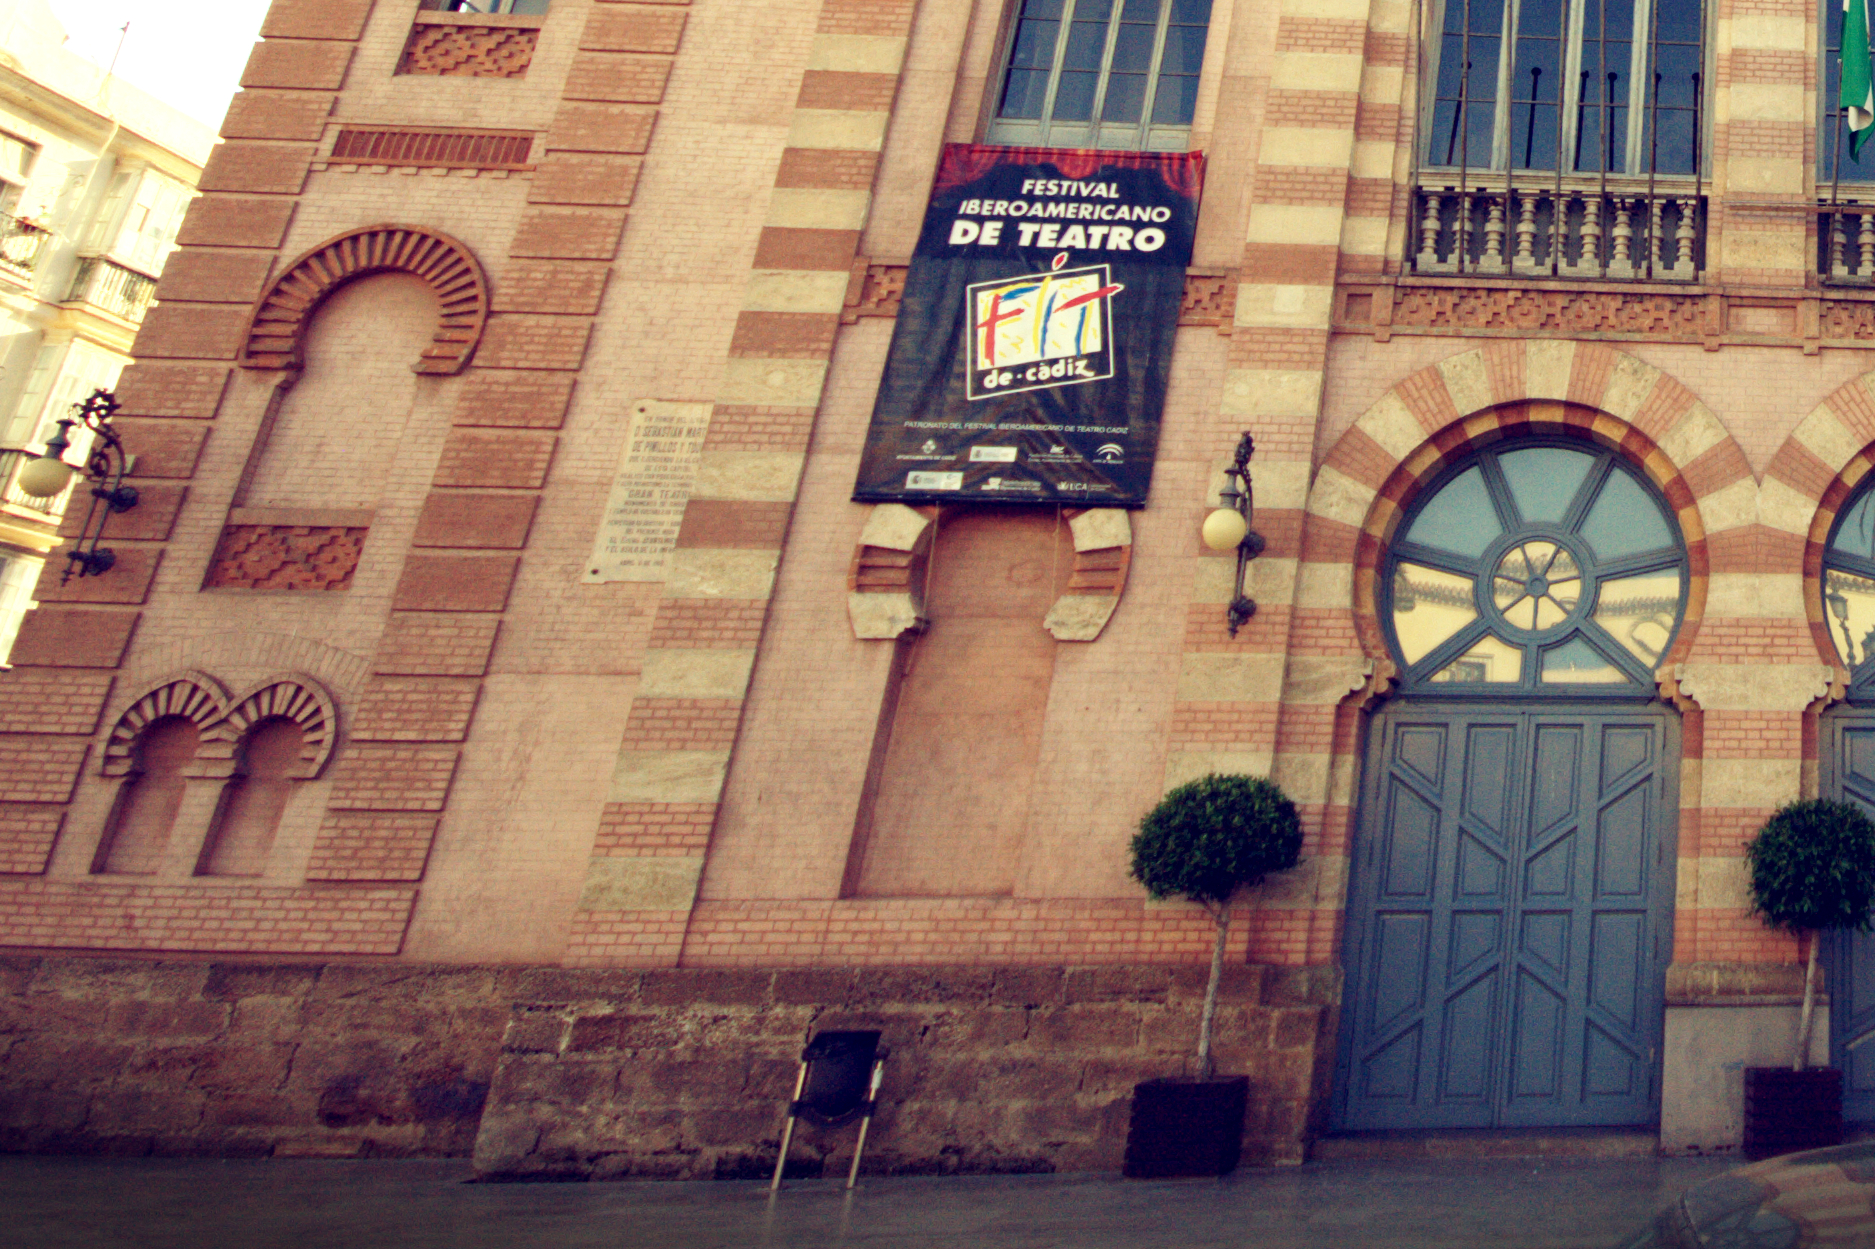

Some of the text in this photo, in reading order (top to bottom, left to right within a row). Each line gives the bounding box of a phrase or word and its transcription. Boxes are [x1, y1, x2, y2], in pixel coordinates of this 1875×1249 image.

[1022, 179, 1119, 198] FESTIVAL
[959, 199, 1171, 223] IBEROAMERICANO
[949, 220, 1166, 252] DE TEATRO
[983, 369, 1013, 388] de
[903, 421, 949, 429] PATRONATO
[998, 423, 1064, 432] IBEROAMERICANO
